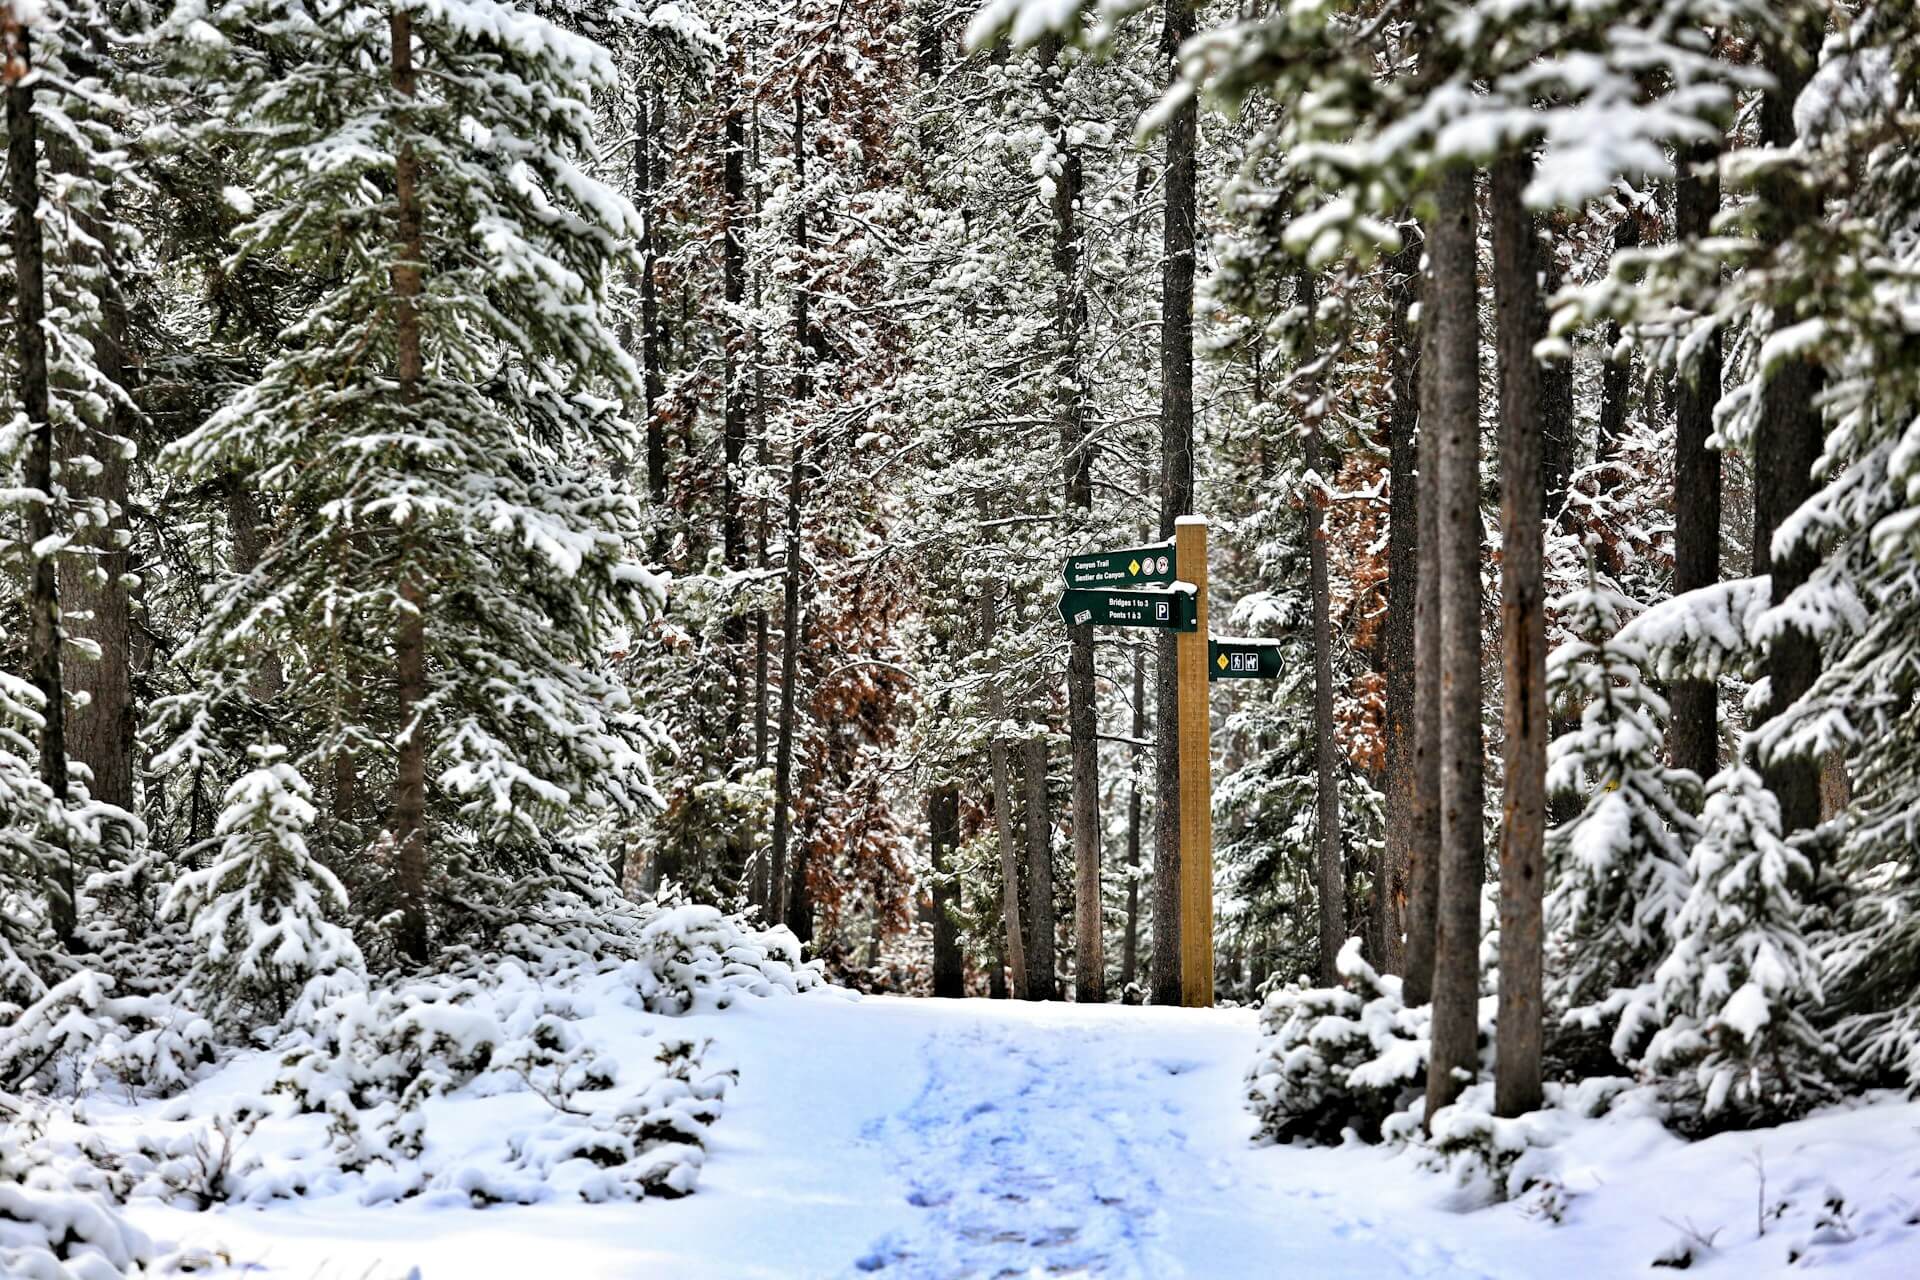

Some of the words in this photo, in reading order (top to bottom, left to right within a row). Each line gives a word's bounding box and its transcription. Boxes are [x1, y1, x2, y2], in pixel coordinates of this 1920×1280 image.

[1075, 562, 1096, 570] Canyon
[1104, 572, 1125, 580] Canyon
[1109, 598, 1131, 607] Bridges
[1109, 611, 1126, 619] Ponts
[1132, 611, 1137, 619] à
[1158, 605, 1166, 618] P
